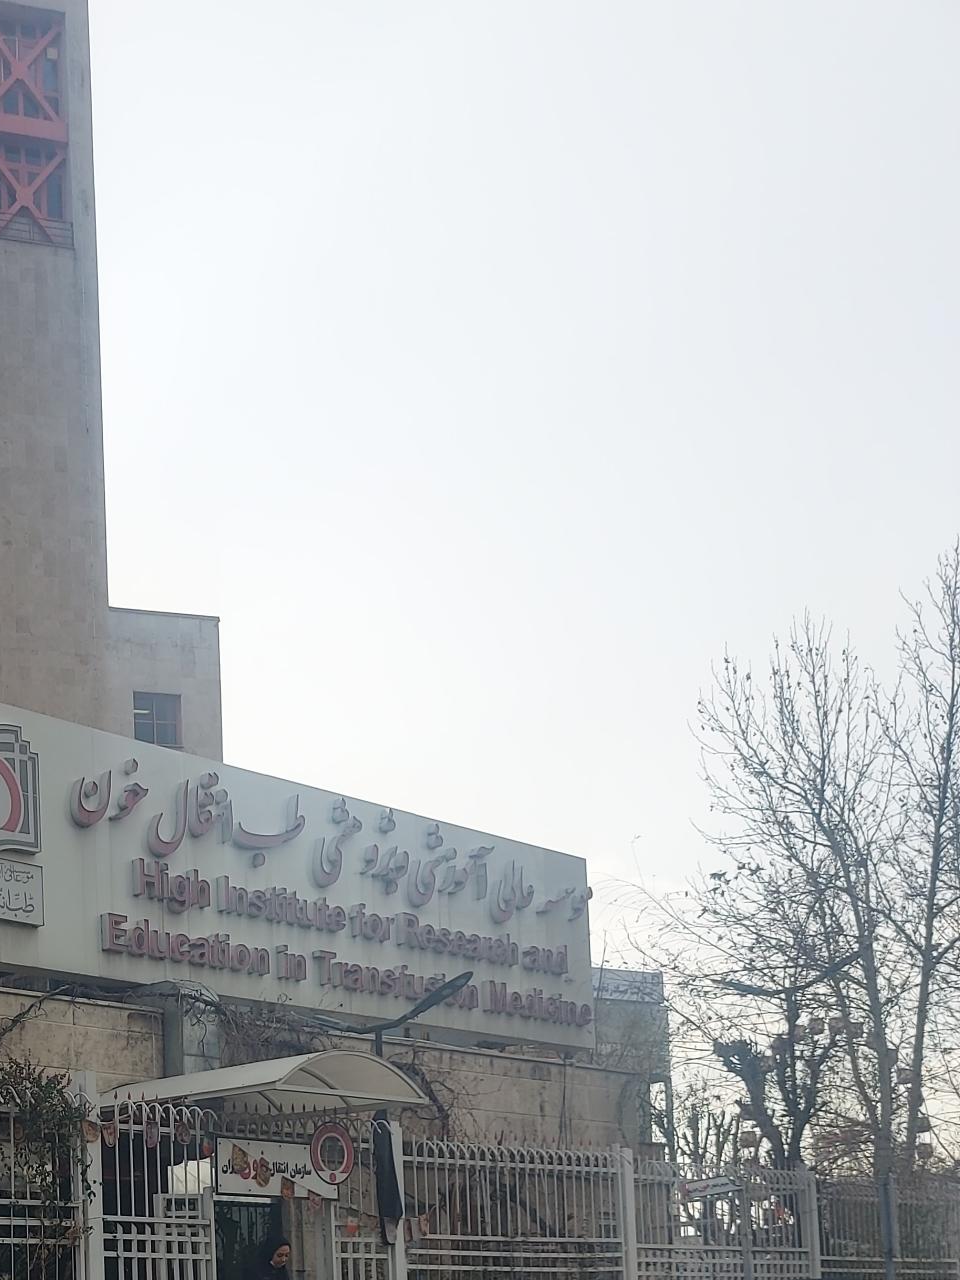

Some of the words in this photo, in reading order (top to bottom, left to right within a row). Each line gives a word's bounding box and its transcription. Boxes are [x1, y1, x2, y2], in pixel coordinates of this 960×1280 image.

[71, 757, 149, 829] خون
[147, 771, 234, 858] انتقال
[233, 793, 307, 869] طب
[406, 822, 496, 908] آموزشی
[490, 858, 535, 924] عالی
[131, 857, 211, 915] High
[216, 874, 347, 933] Institute
[347, 902, 392, 944] for
[392, 911, 520, 968] Research
[521, 944, 570, 977] and
[100, 912, 271, 977] Education
[275, 944, 307, 981] in
[482, 979, 593, 1028] Medicine
